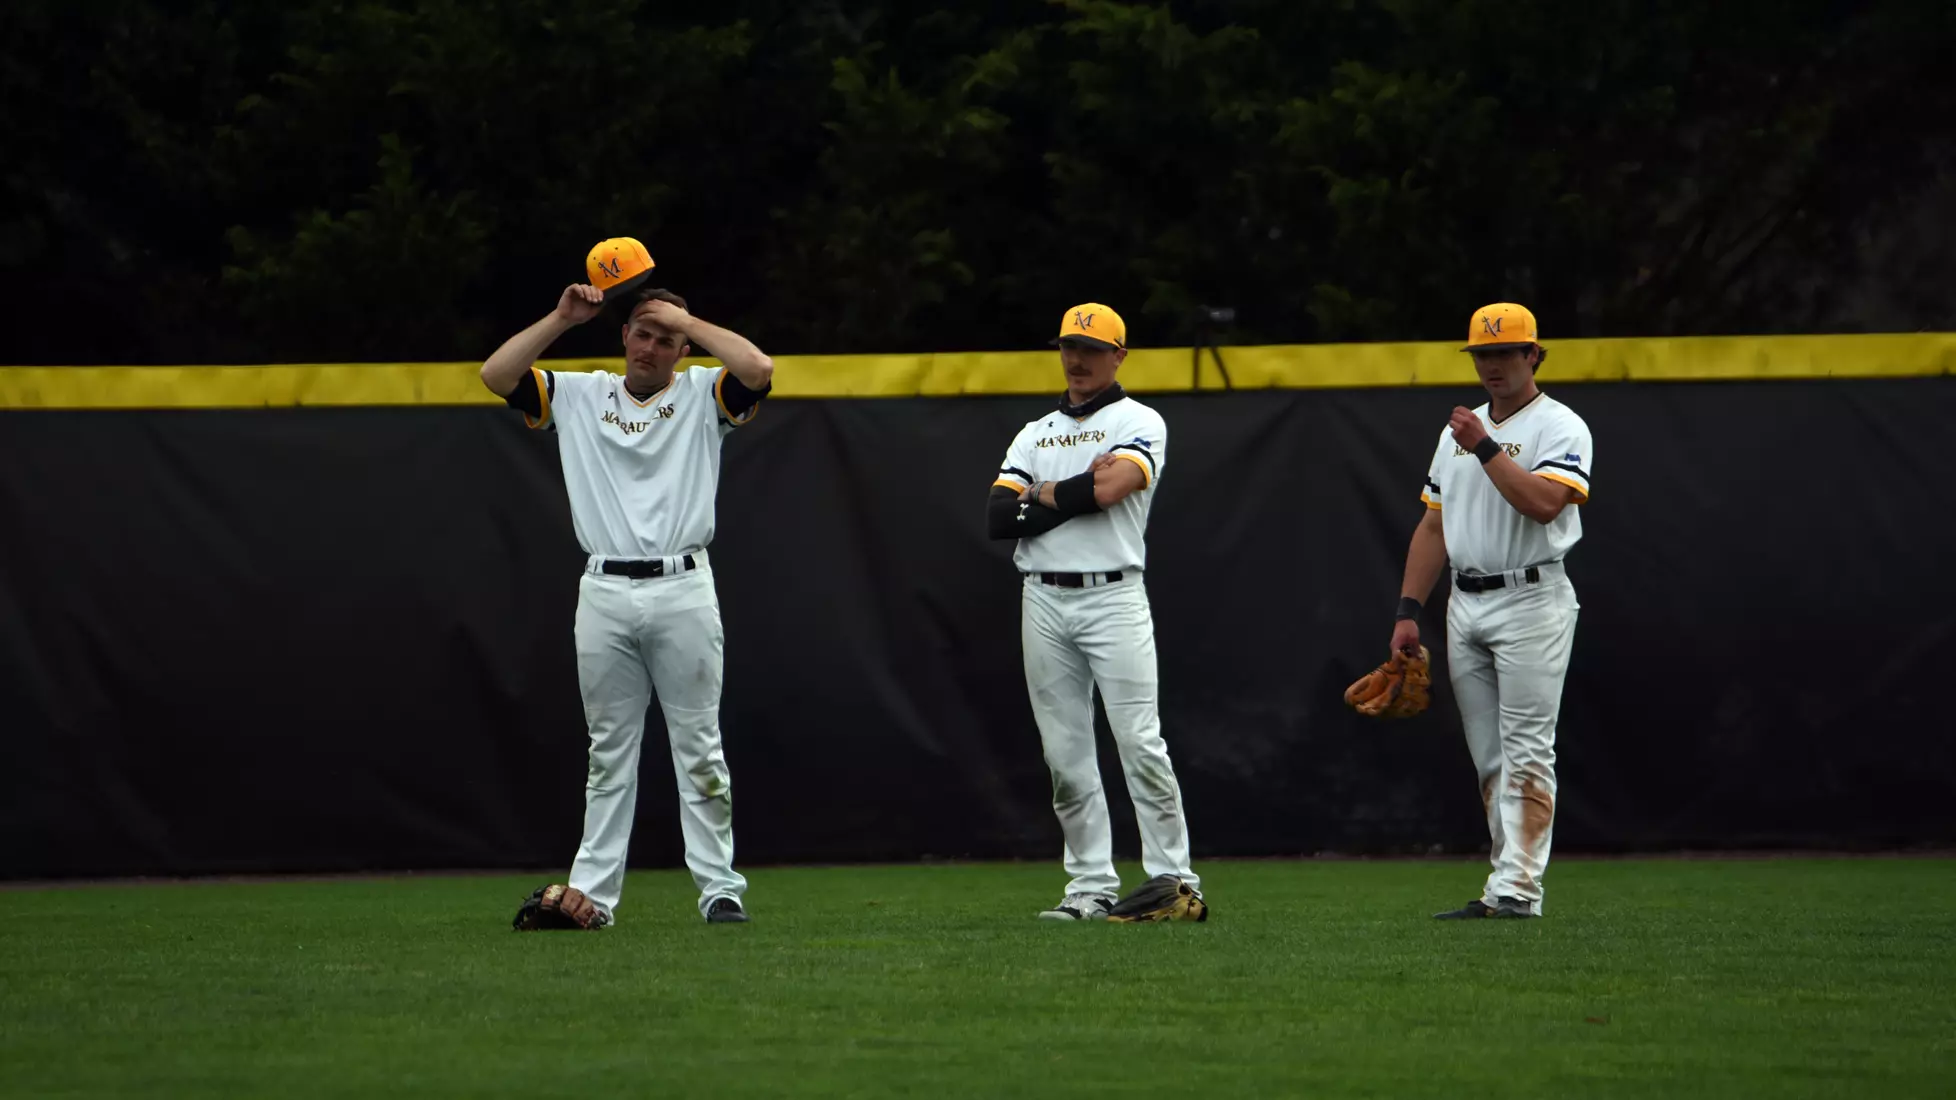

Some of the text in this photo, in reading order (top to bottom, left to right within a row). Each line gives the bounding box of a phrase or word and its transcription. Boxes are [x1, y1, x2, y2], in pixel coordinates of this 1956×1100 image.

[598, 257, 624, 279] M
[1073, 310, 1095, 331] M
[1482, 316, 1503, 338] M
[600, 403, 675, 435] MARAURS
